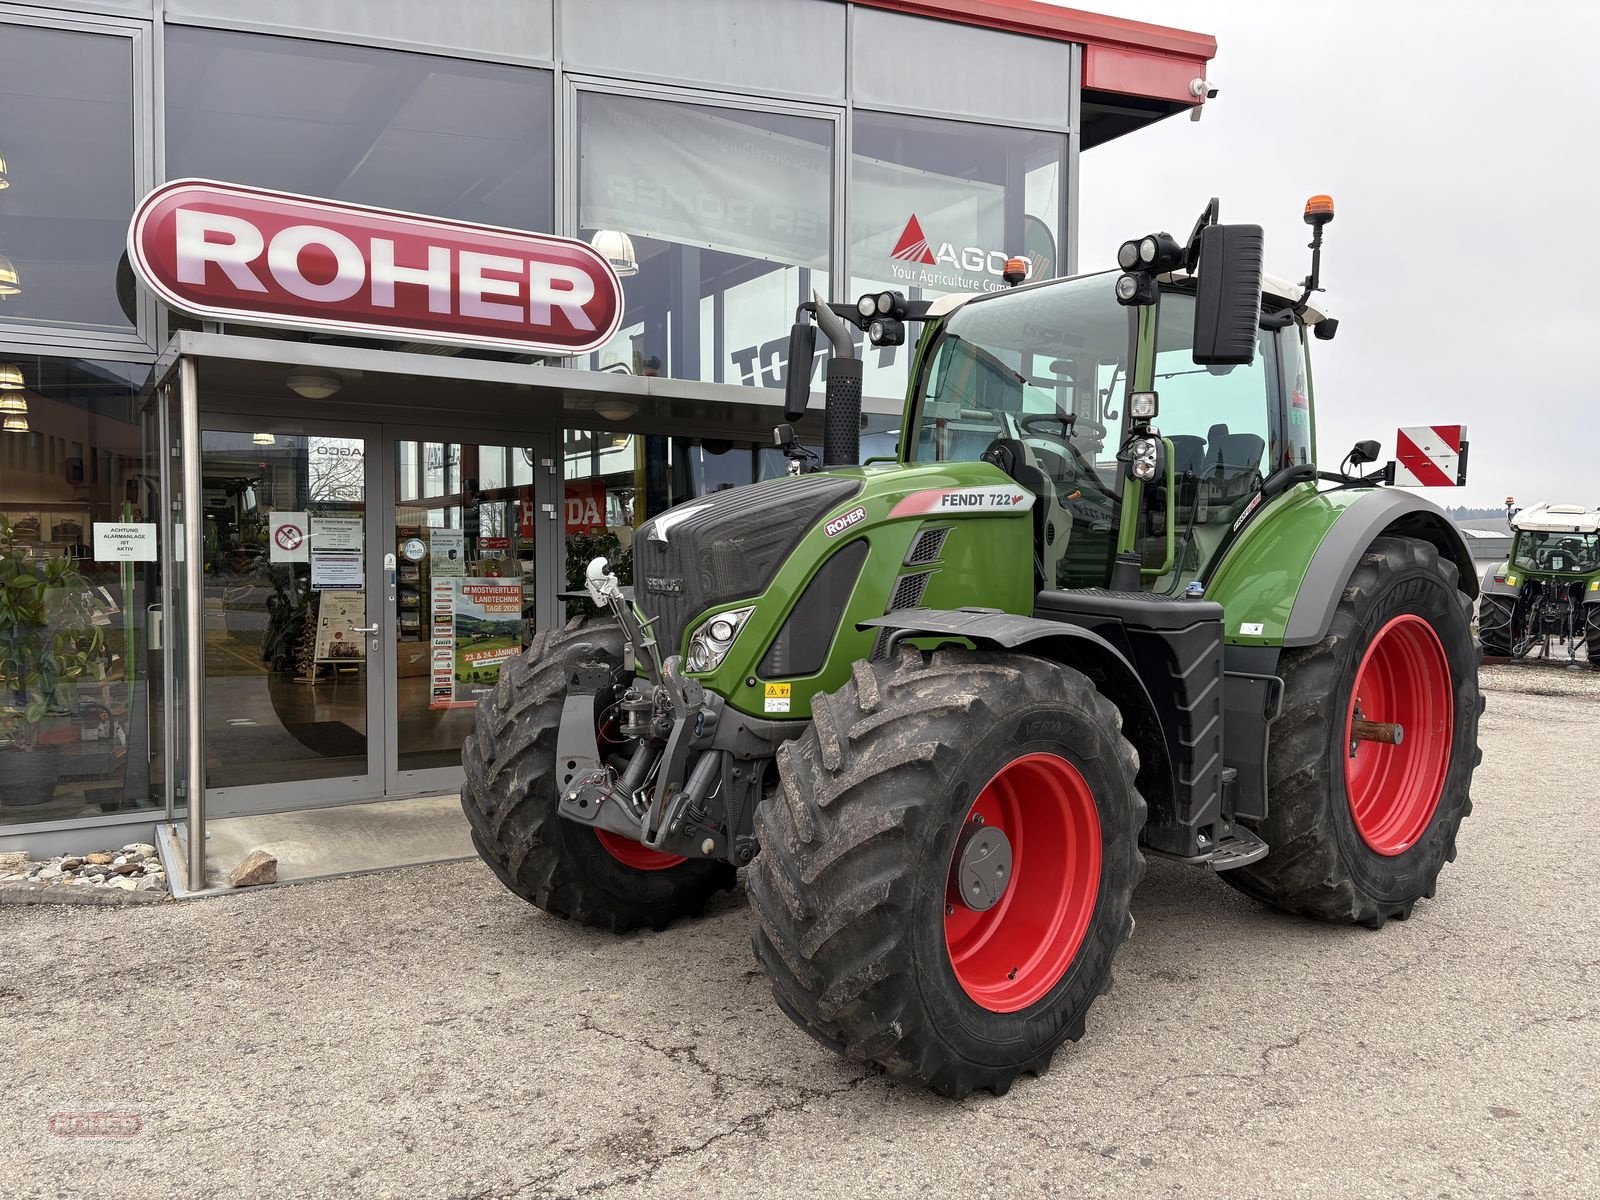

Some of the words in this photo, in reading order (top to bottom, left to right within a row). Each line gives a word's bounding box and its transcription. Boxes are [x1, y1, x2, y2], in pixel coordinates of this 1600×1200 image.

[175, 207, 597, 332] ROHER
[891, 264, 916, 280] Your
[919, 270, 979, 290] Agriculture
[521, 497, 601, 526] HDA
[941, 494, 984, 507] FENDT
[989, 494, 1011, 506] 722
[826, 508, 866, 535] ROHER
[471, 586, 519, 594] MOSTVIERTLER
[494, 647, 519, 657] JÄNNER
